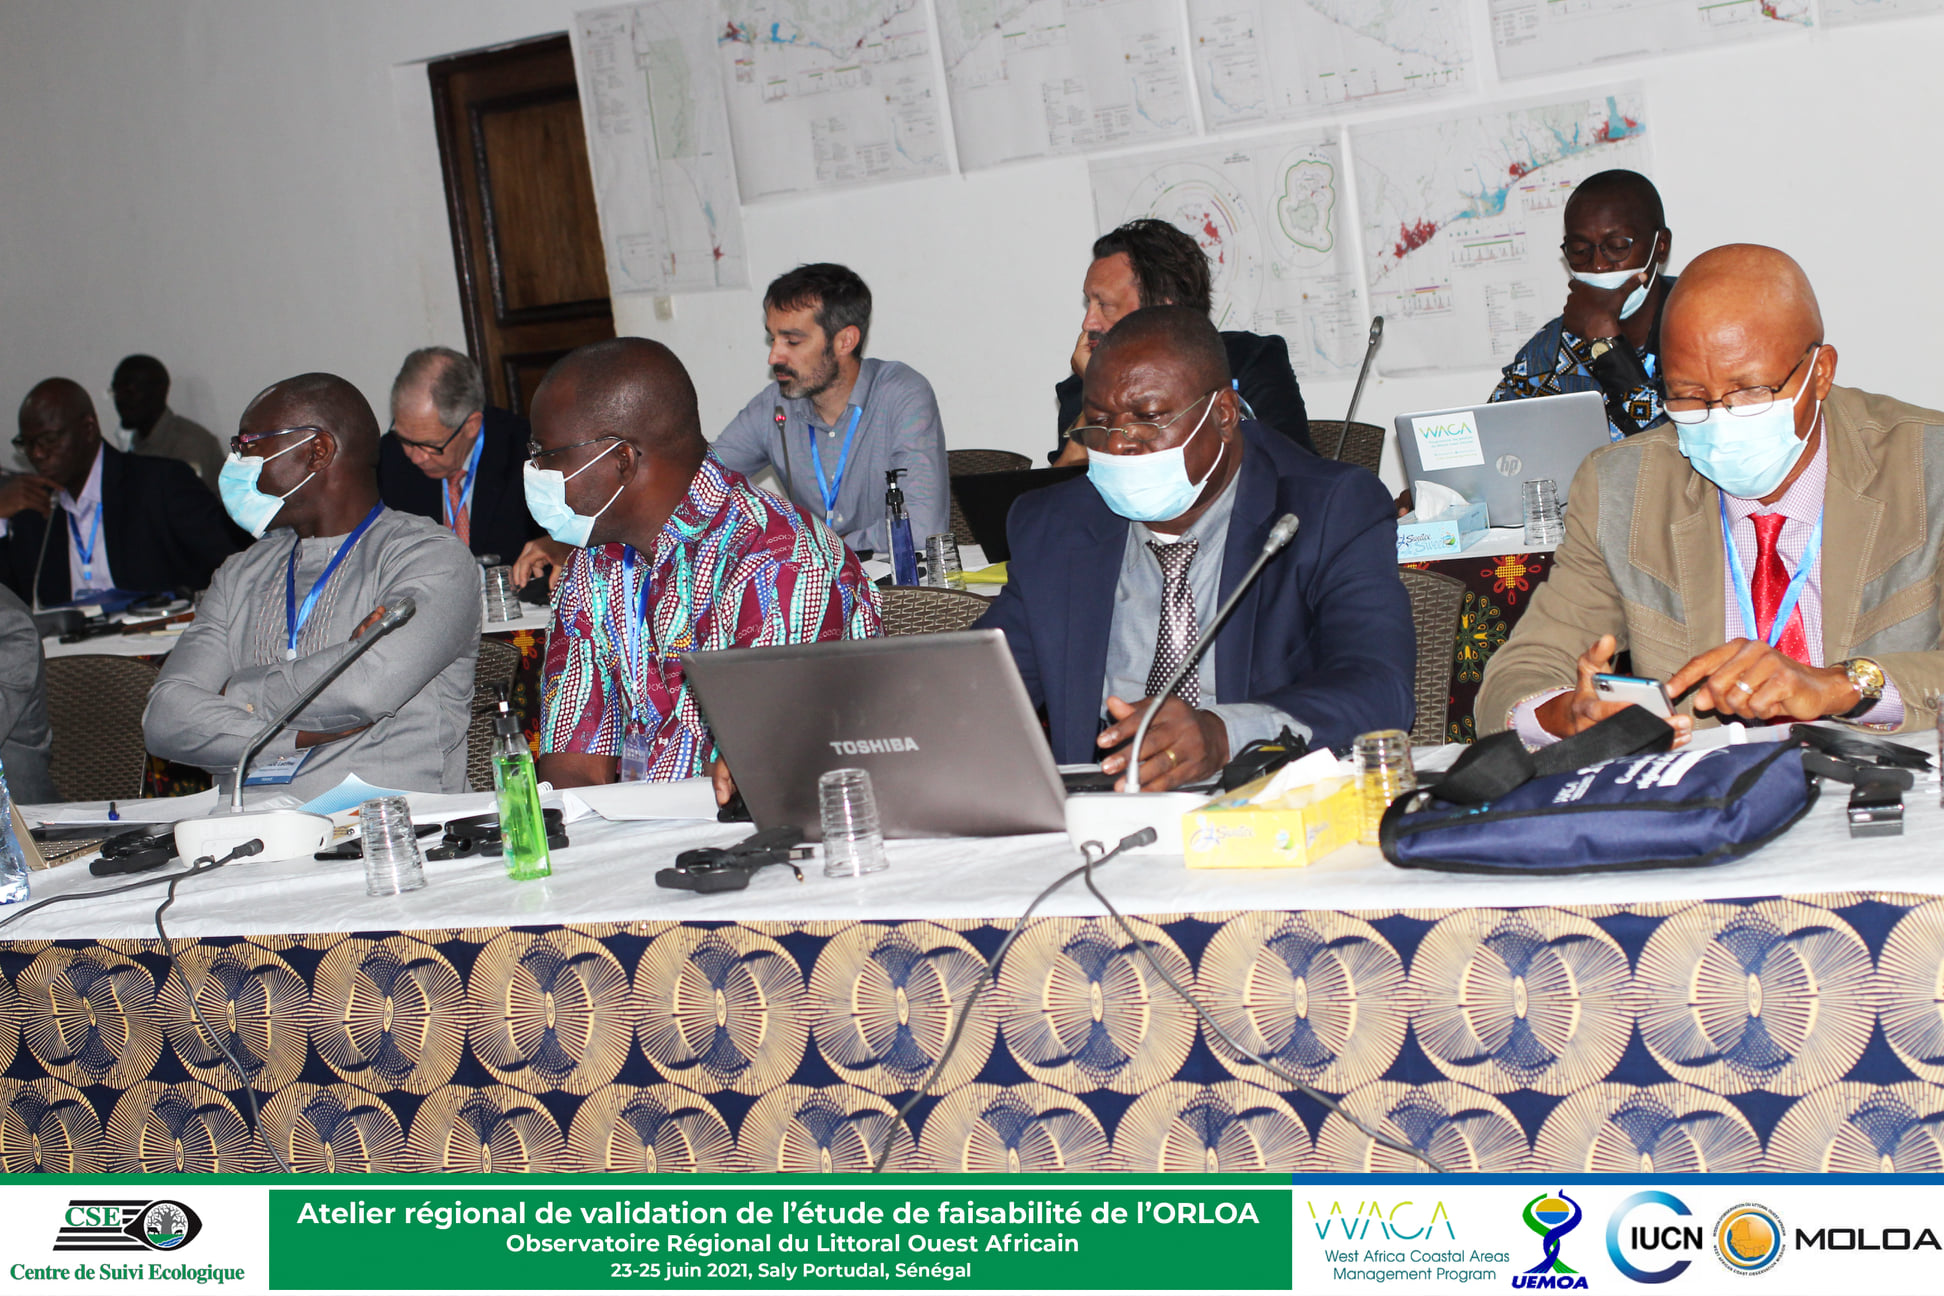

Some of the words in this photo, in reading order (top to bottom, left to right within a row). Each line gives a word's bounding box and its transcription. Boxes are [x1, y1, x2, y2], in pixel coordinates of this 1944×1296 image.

[1419, 421, 1473, 439] WACA
[1500, 456, 1519, 476] hp
[829, 737, 920, 755] TOSHIBA
